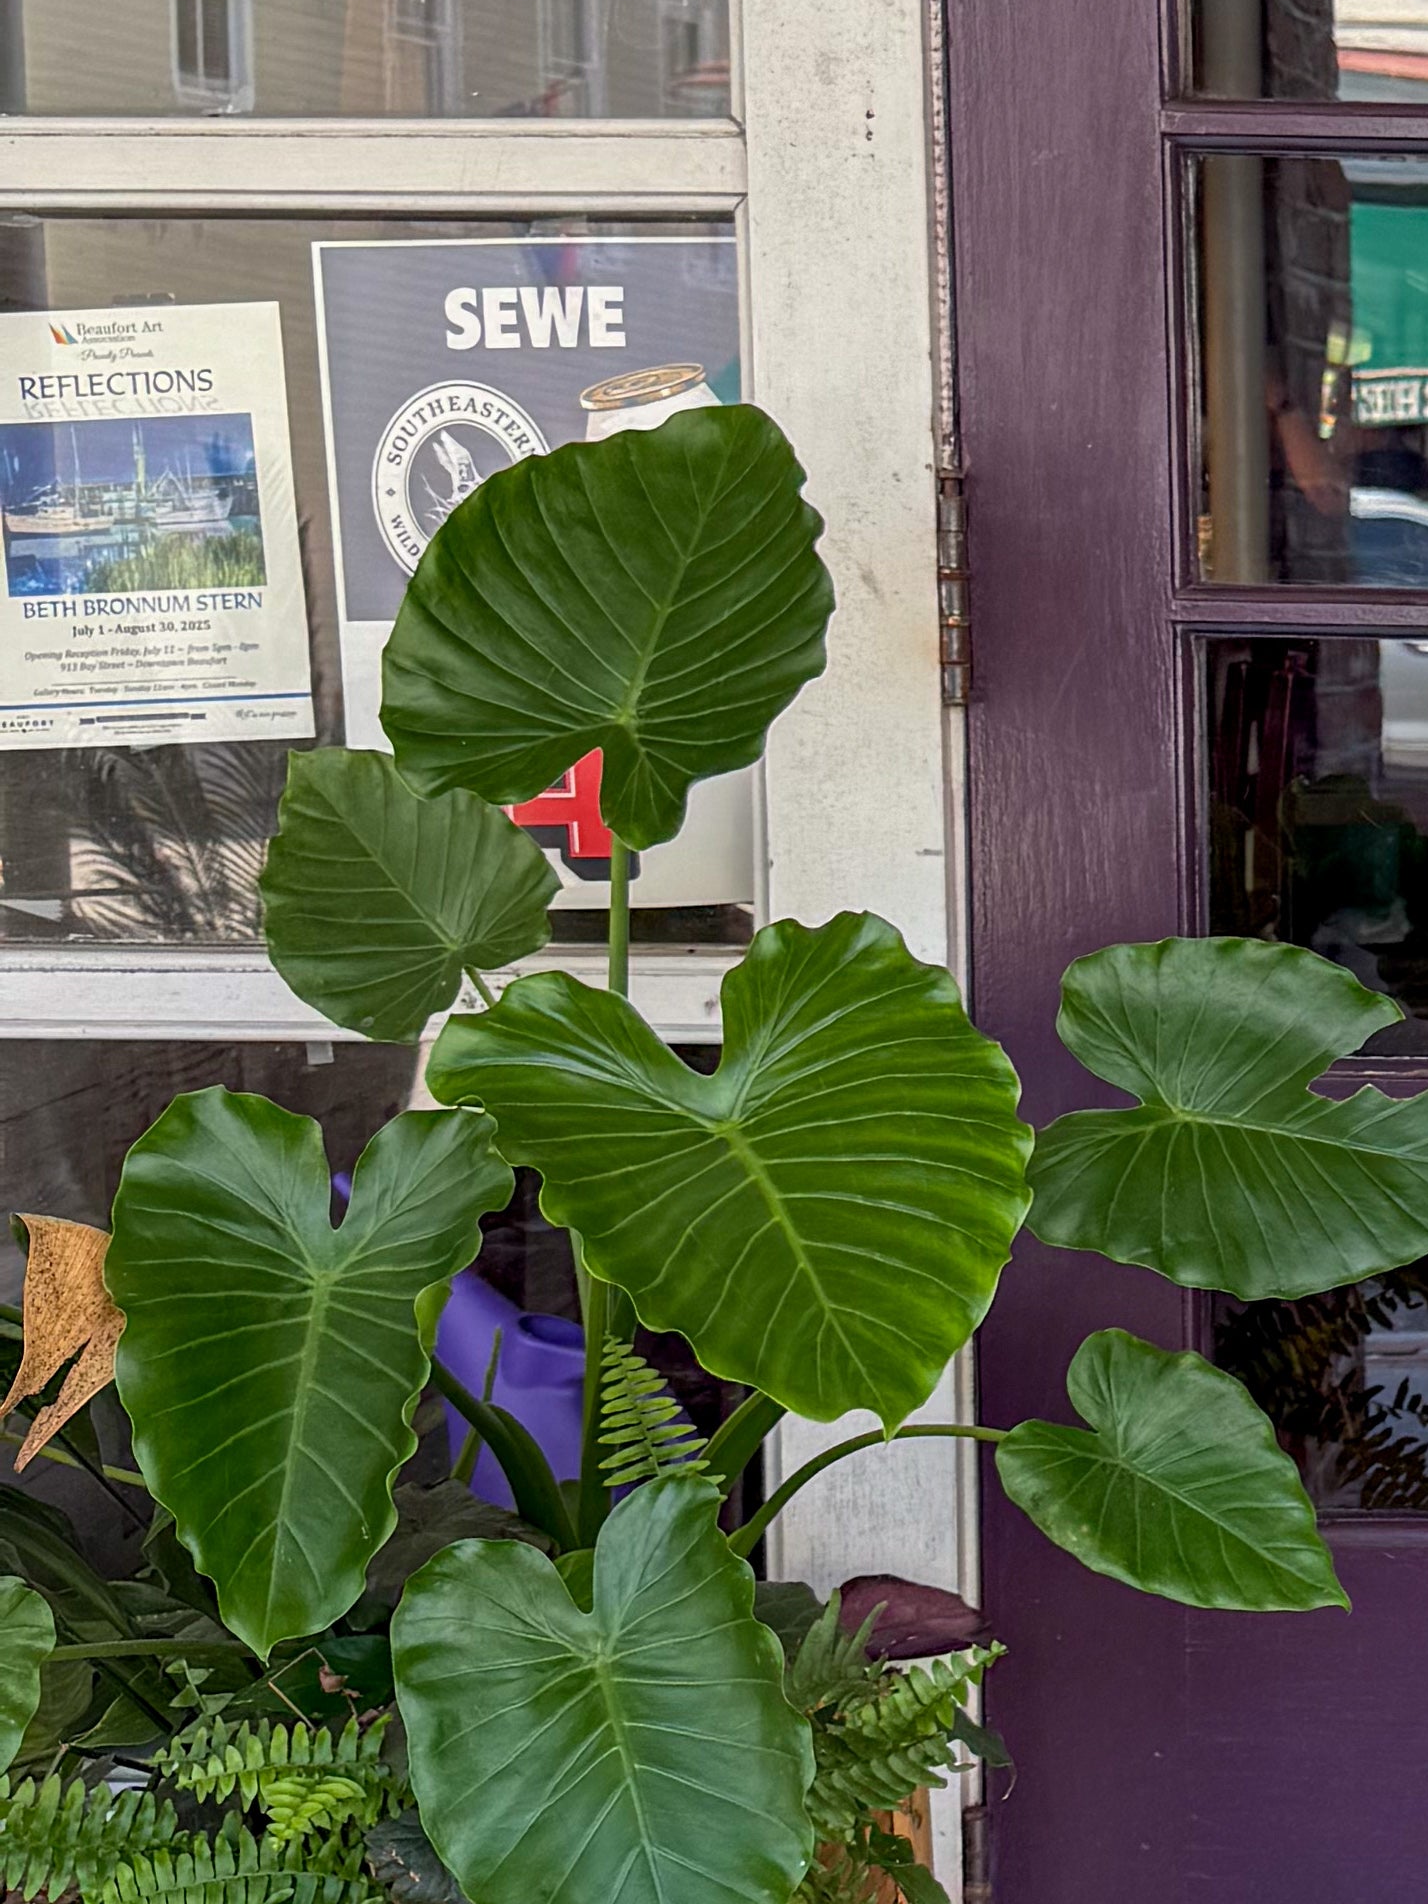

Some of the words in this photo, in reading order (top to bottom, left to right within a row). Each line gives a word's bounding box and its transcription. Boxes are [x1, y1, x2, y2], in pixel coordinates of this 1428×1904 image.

[77, 323, 137, 336] Beaufort
[142, 322, 163, 334] Art
[444, 286, 626, 350] SEWE
[19, 369, 213, 400] REFLECTIONS
[23, 601, 77, 619] BETH
[84, 596, 190, 616] BRONNUM
[196, 592, 263, 611] STERN
[72, 625, 95, 638] July
[99, 625, 104, 634] 1
[115, 623, 156, 636] August
[159, 622, 178, 633] 30,
